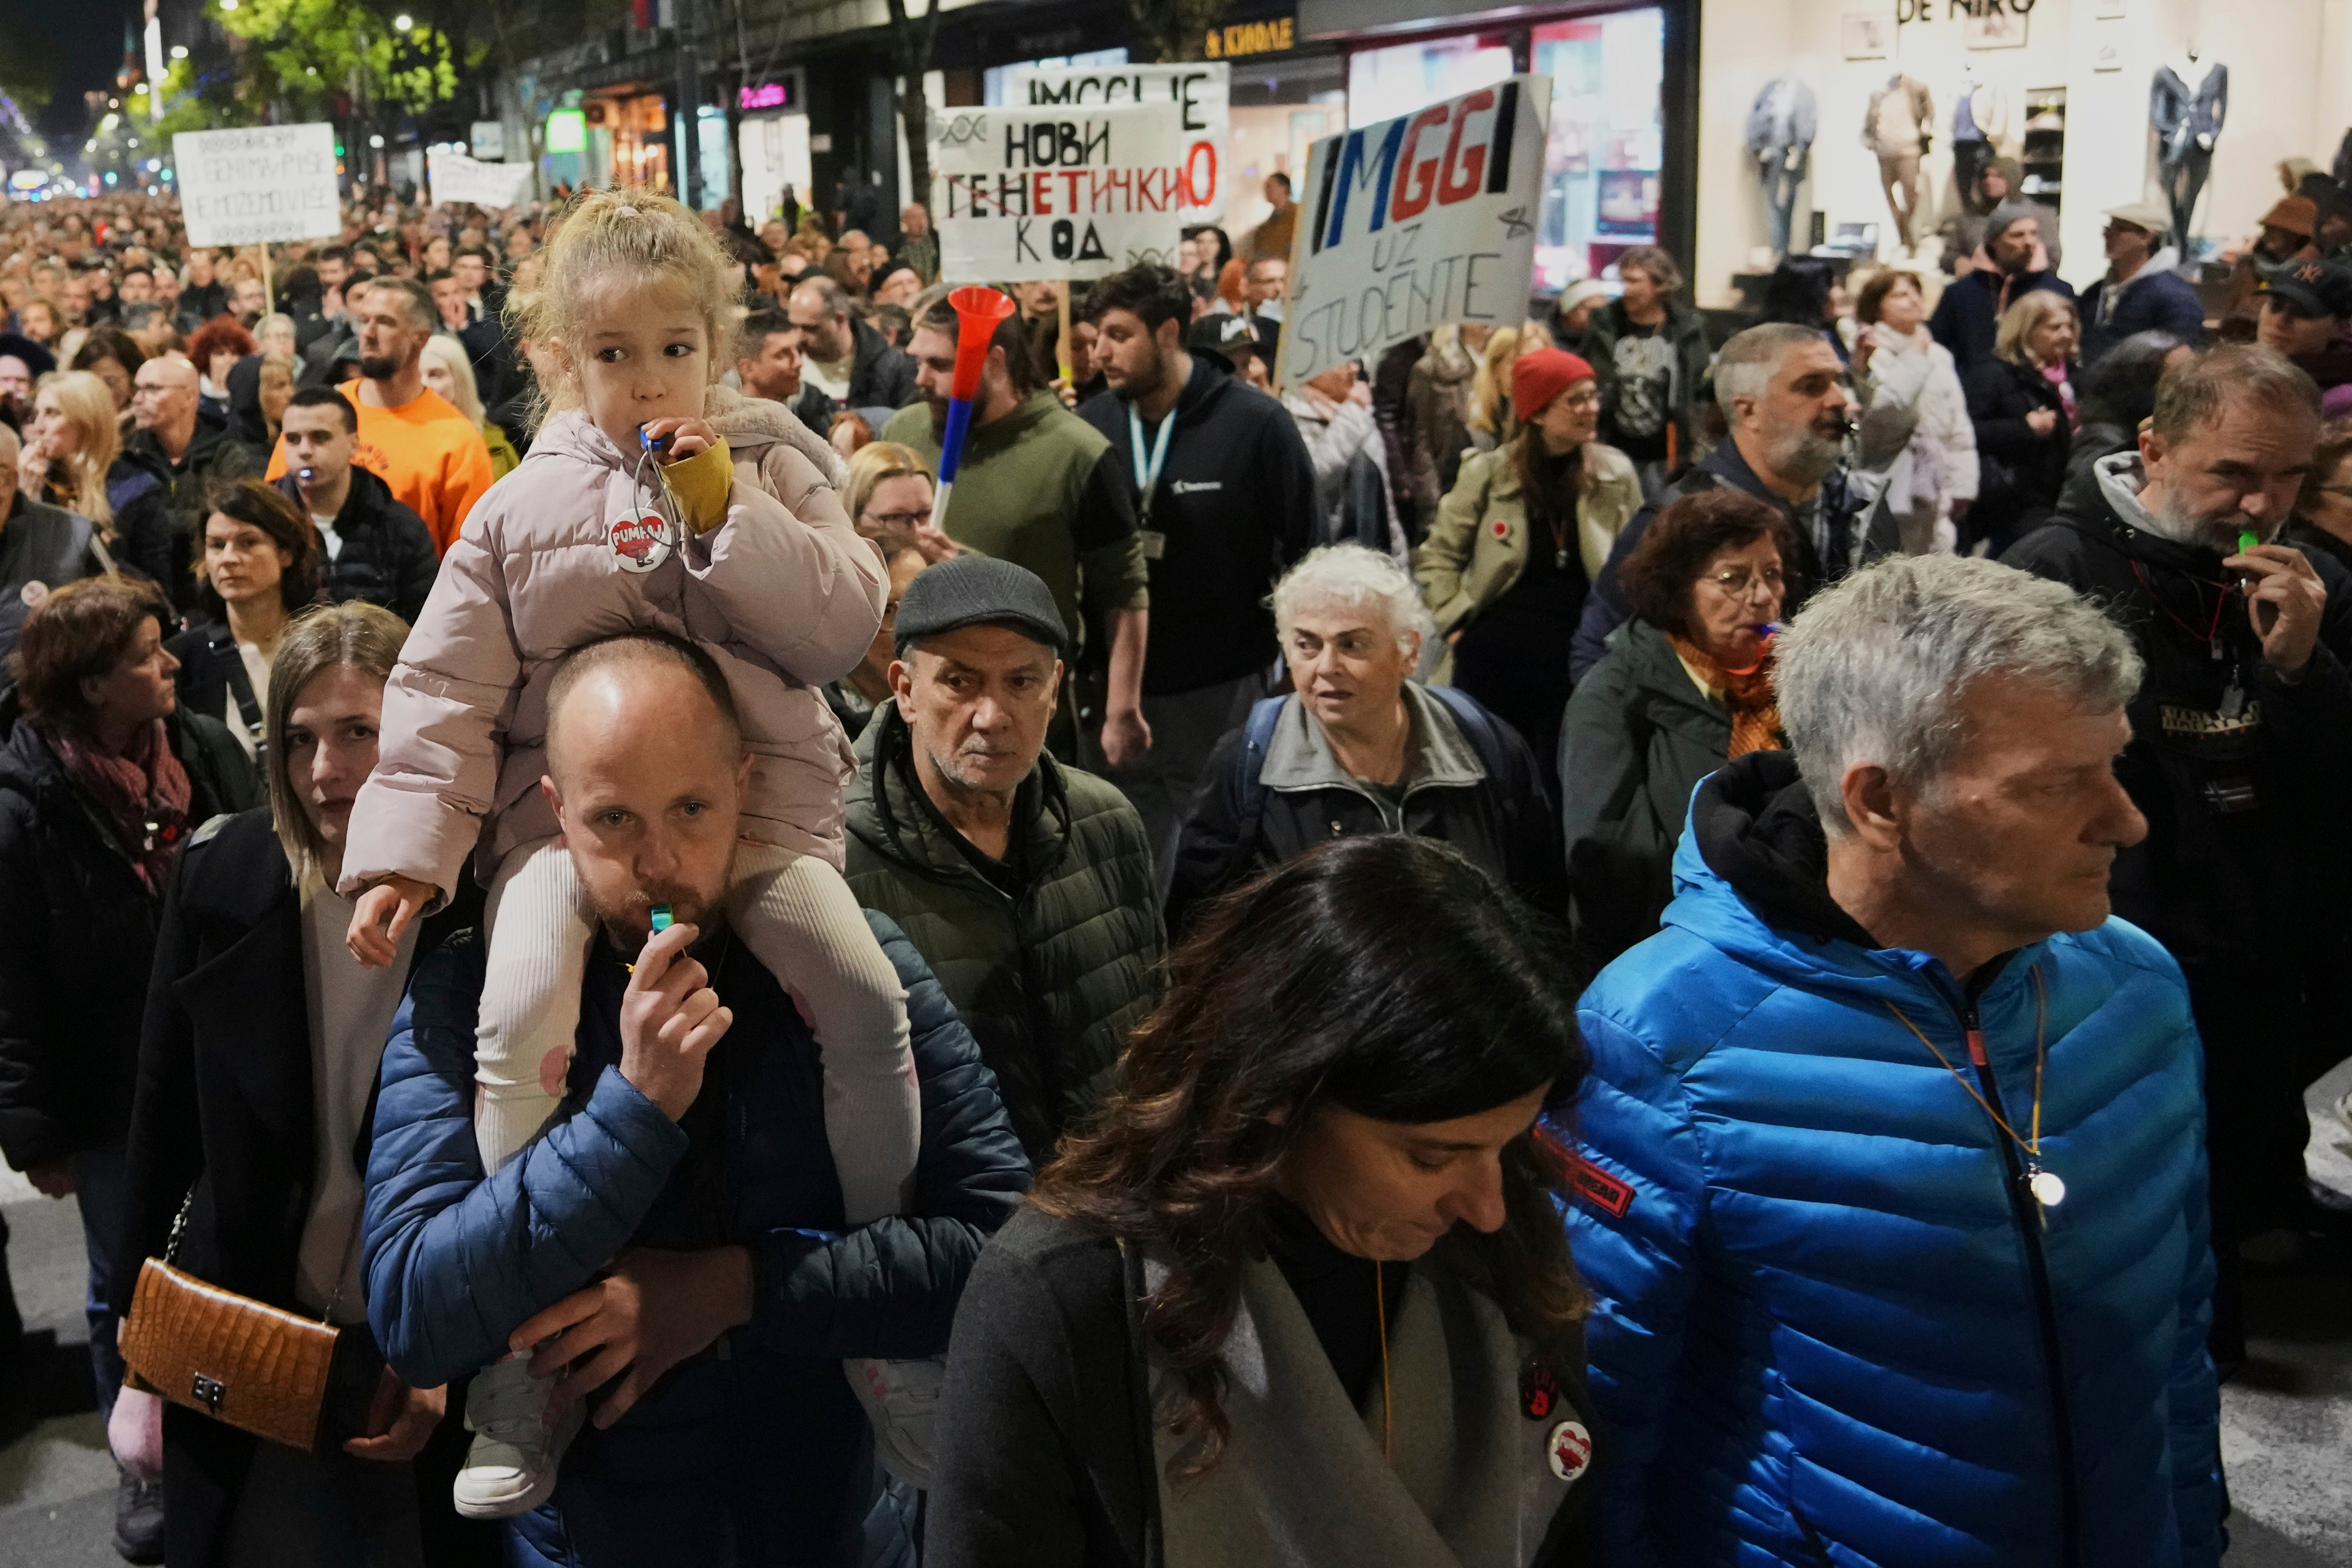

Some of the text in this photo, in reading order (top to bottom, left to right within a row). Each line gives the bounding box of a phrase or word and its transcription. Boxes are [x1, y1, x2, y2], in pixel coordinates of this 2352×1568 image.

[1898, 0, 1931, 24] DE
[1004, 120, 1109, 168] НОВИ
[1311, 81, 1519, 256] IMGGI
[946, 167, 1181, 218] ГЕНЕТИЧКИ
[1015, 218, 1113, 263] КОД
[1372, 223, 1423, 273] UZ
[1294, 253, 1502, 378] STUDENTE
[612, 524, 662, 546] PUMPAJ
